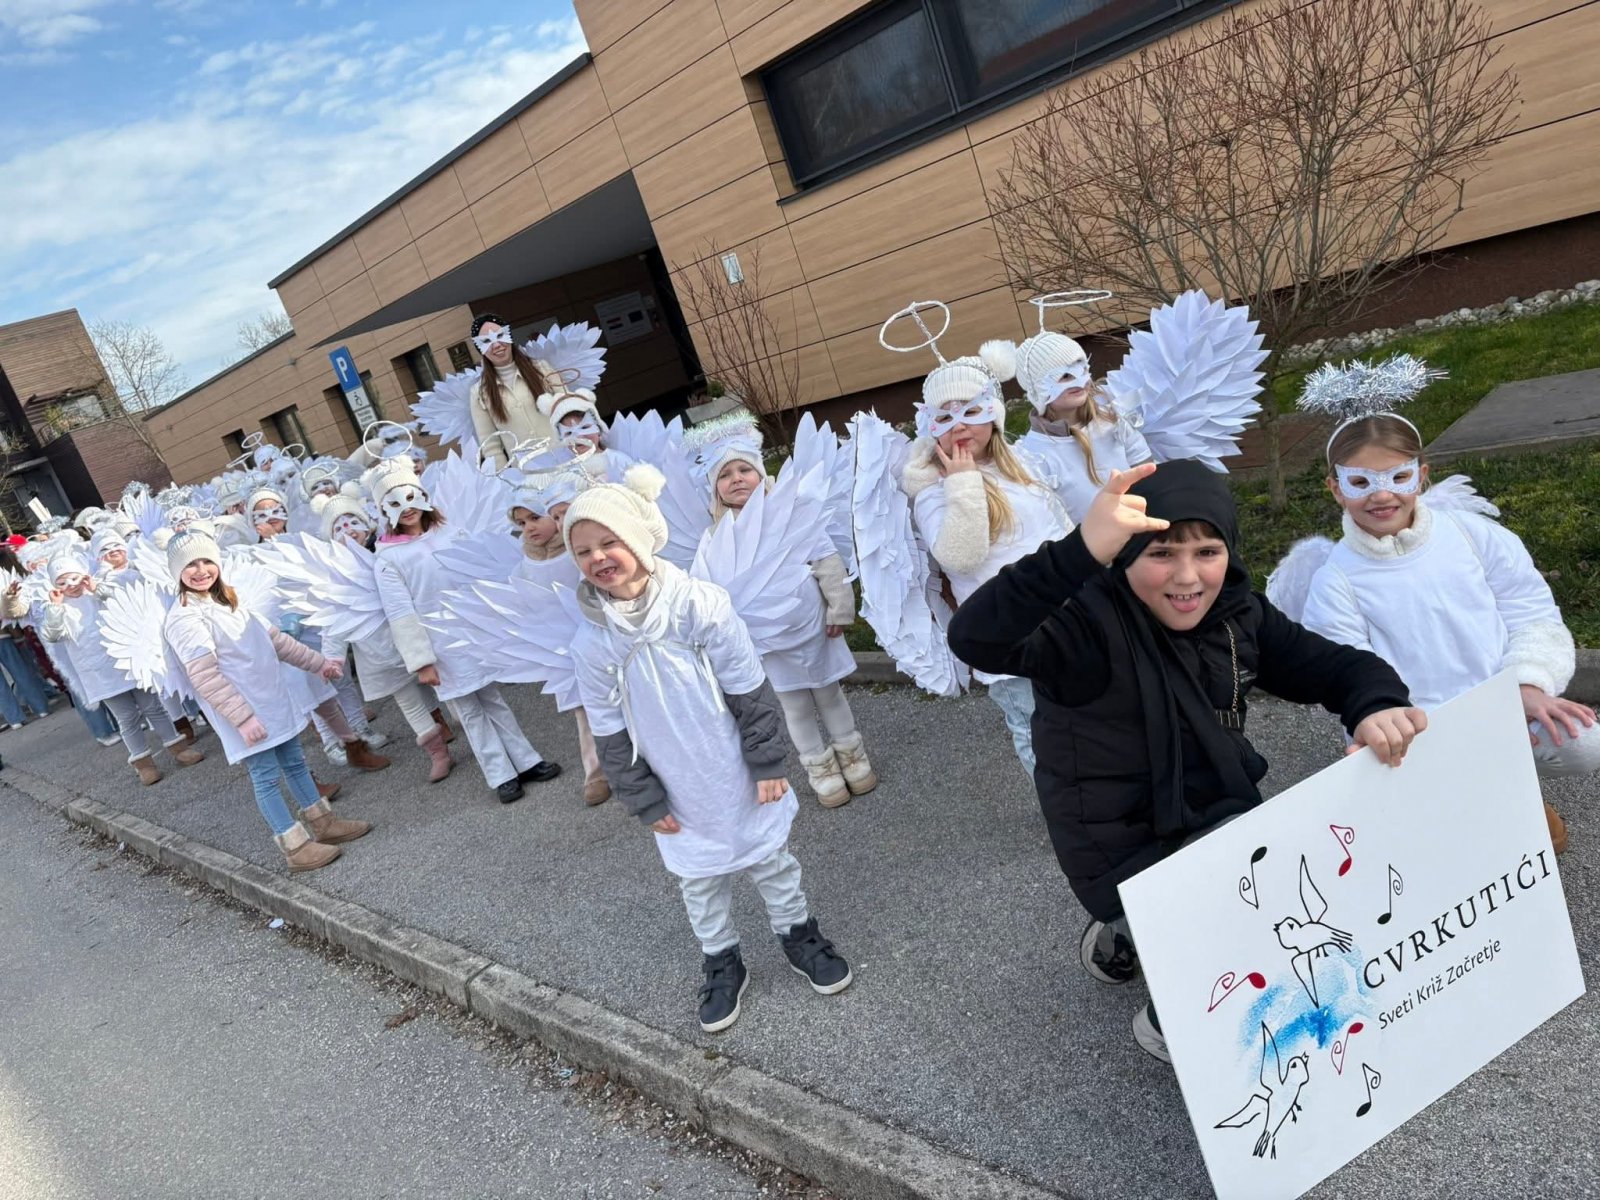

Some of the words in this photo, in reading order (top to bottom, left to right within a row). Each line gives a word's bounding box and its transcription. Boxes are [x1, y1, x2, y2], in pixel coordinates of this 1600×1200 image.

[336, 357, 348, 382] P
[1363, 850, 1550, 989] CVRKUTIĆI
[1378, 993, 1414, 1030] Sveti
[1416, 976, 1444, 1004] Križ
[1446, 939, 1501, 985] Začretje
